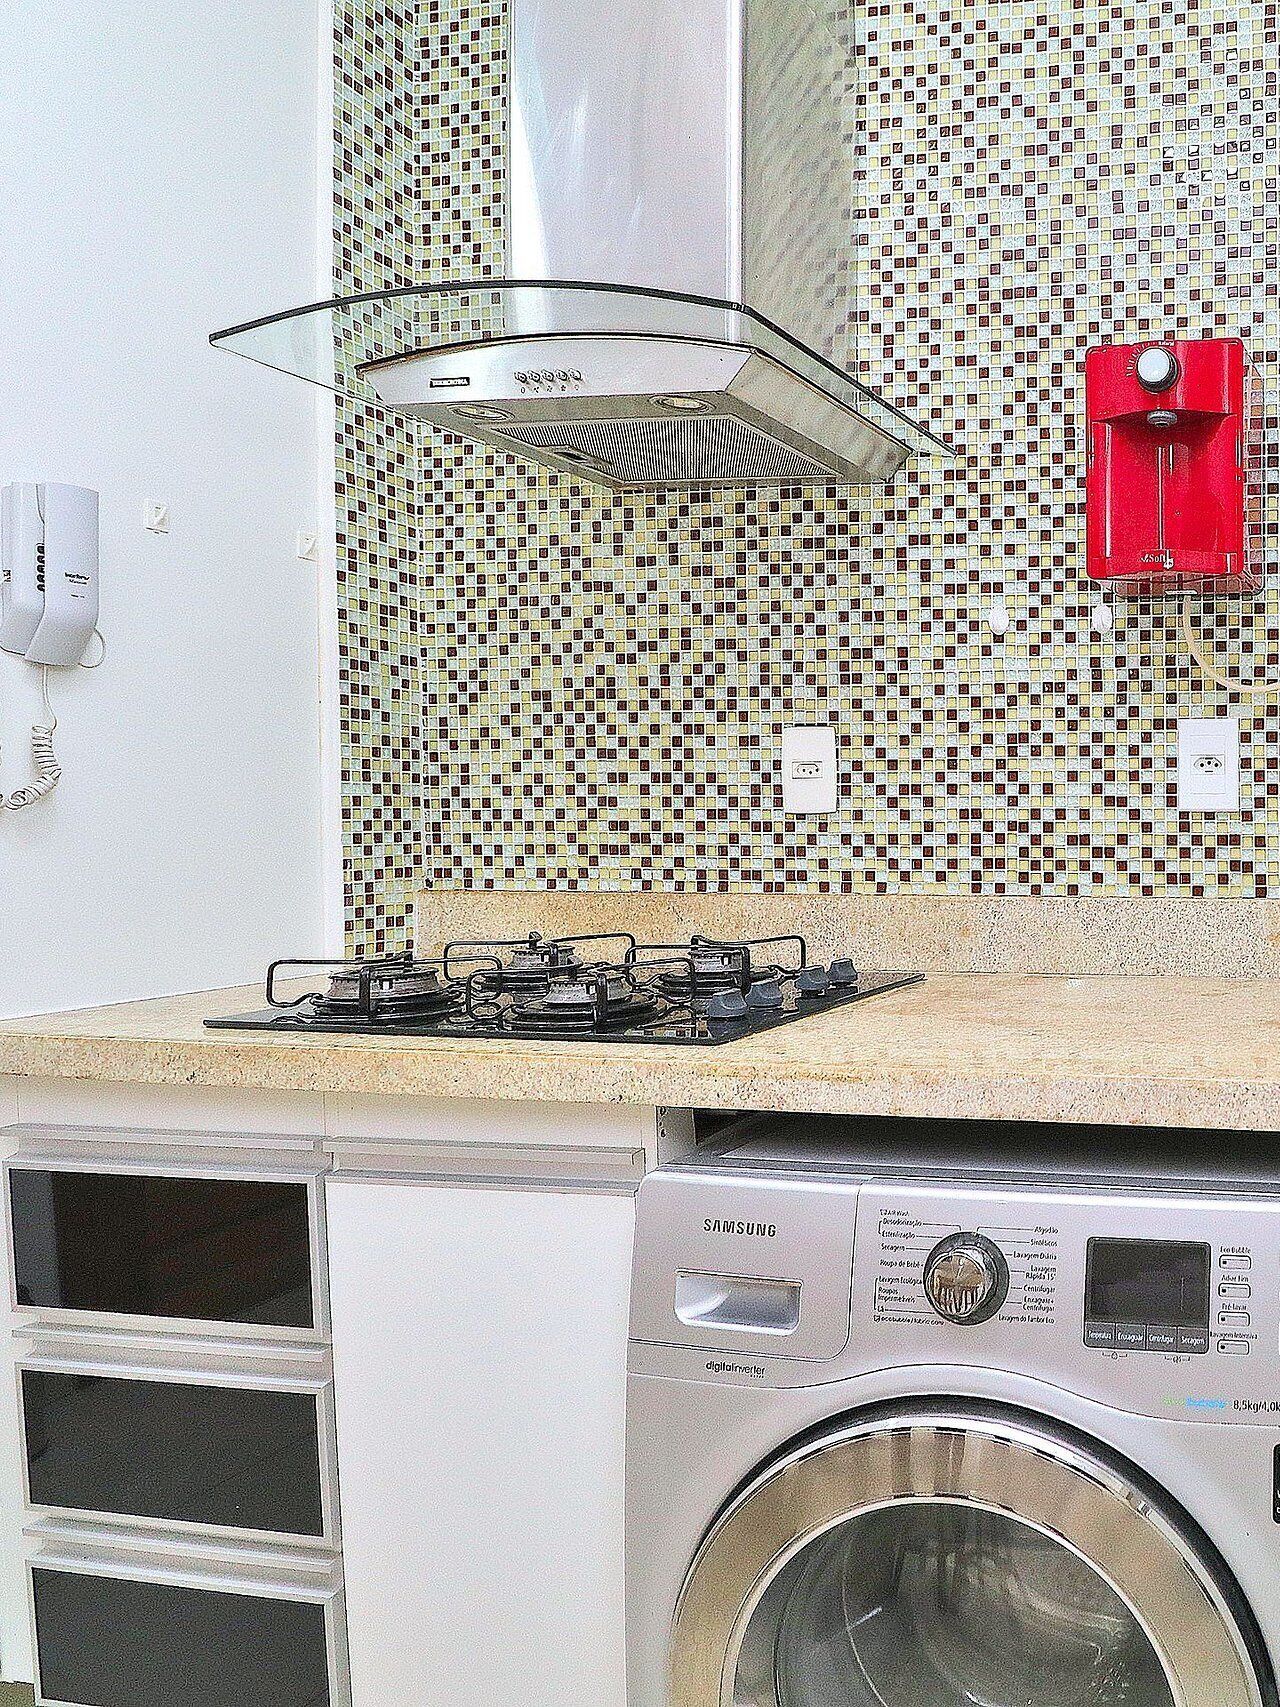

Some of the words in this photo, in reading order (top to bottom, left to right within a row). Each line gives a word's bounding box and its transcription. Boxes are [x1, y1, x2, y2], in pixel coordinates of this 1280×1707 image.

[703, 1218, 776, 1238] SAMSUNG
[1034, 1226, 1059, 1235] Algodão
[881, 1243, 905, 1252] Secagem
[1030, 1239, 1058, 1247] Sintéticos
[1013, 1250, 1039, 1260] Lavagem
[1030, 1264, 1057, 1274] Lavagem
[1025, 1272, 1046, 1281] Rápida
[1023, 1284, 1056, 1295] Centrifugar
[1022, 1303, 1055, 1313] Centrifugar
